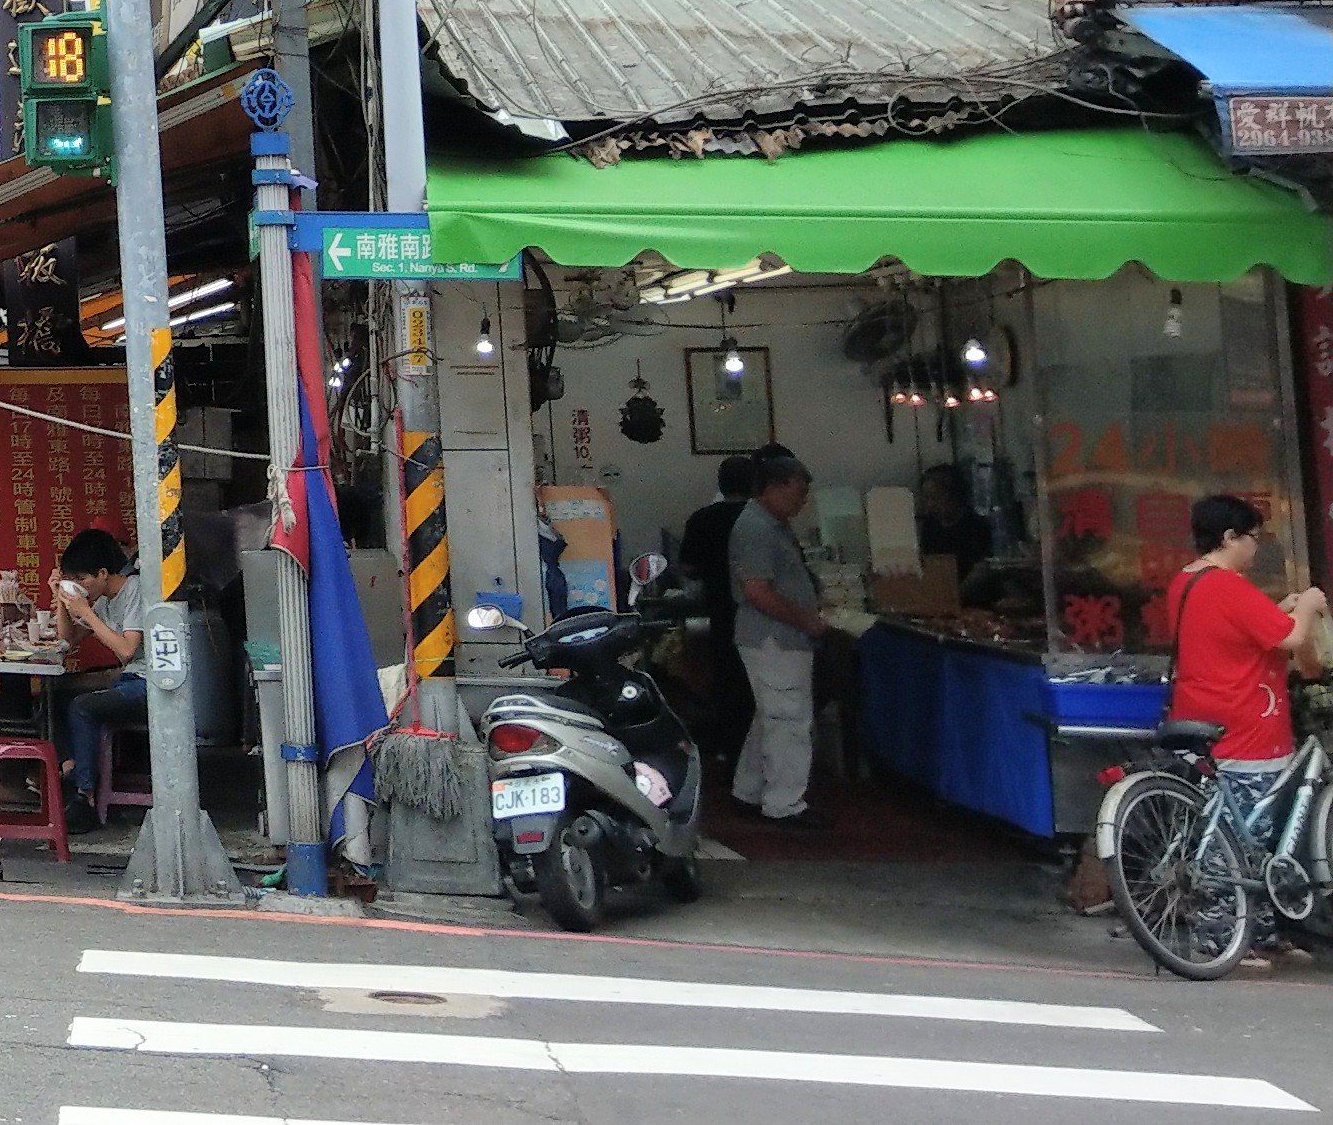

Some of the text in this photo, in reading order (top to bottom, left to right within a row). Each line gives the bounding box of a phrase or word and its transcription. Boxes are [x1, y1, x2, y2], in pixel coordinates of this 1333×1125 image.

[47, 31, 84, 83] 18
[372, 261, 396, 273] Sec.
[409, 262, 444, 276] Nanya
[460, 262, 479, 274] Rd.
[495, 786, 561, 811] CJK-183
